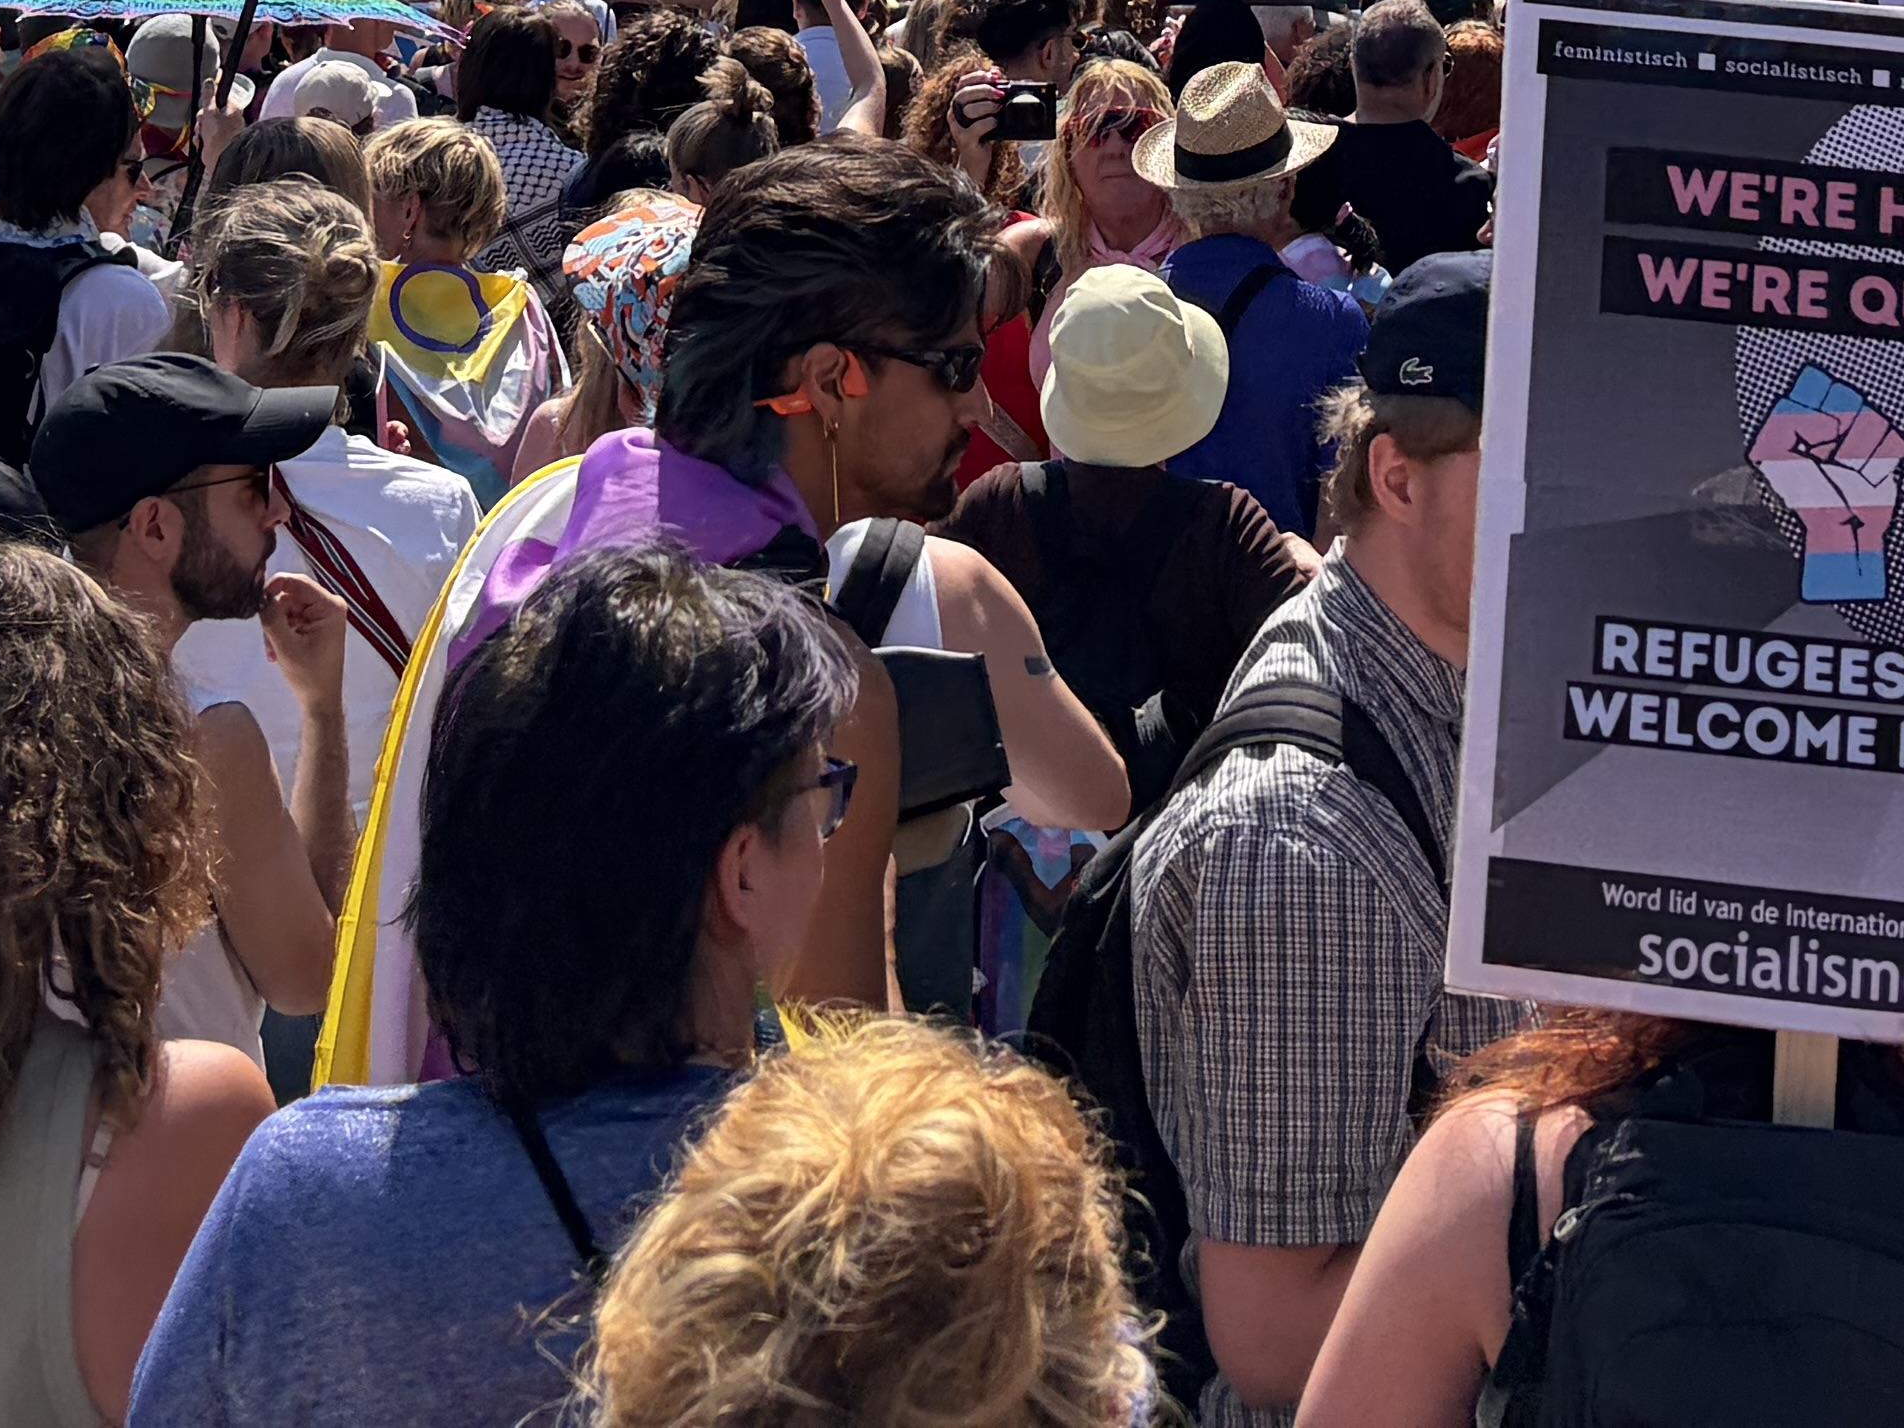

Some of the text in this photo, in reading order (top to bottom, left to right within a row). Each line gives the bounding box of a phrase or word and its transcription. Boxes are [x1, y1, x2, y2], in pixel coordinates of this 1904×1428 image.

[1554, 39, 1688, 69] feministisch
[1725, 56, 1864, 86] socialistisch
[1666, 163, 1858, 231] WE'RE
[1637, 251, 1829, 319] WE'RE
[1566, 686, 1878, 767] WELCOME
[1600, 881, 1662, 913] Word
[1669, 885, 1697, 917] lid
[1703, 896, 1744, 922] van
[1749, 896, 1779, 925] de
